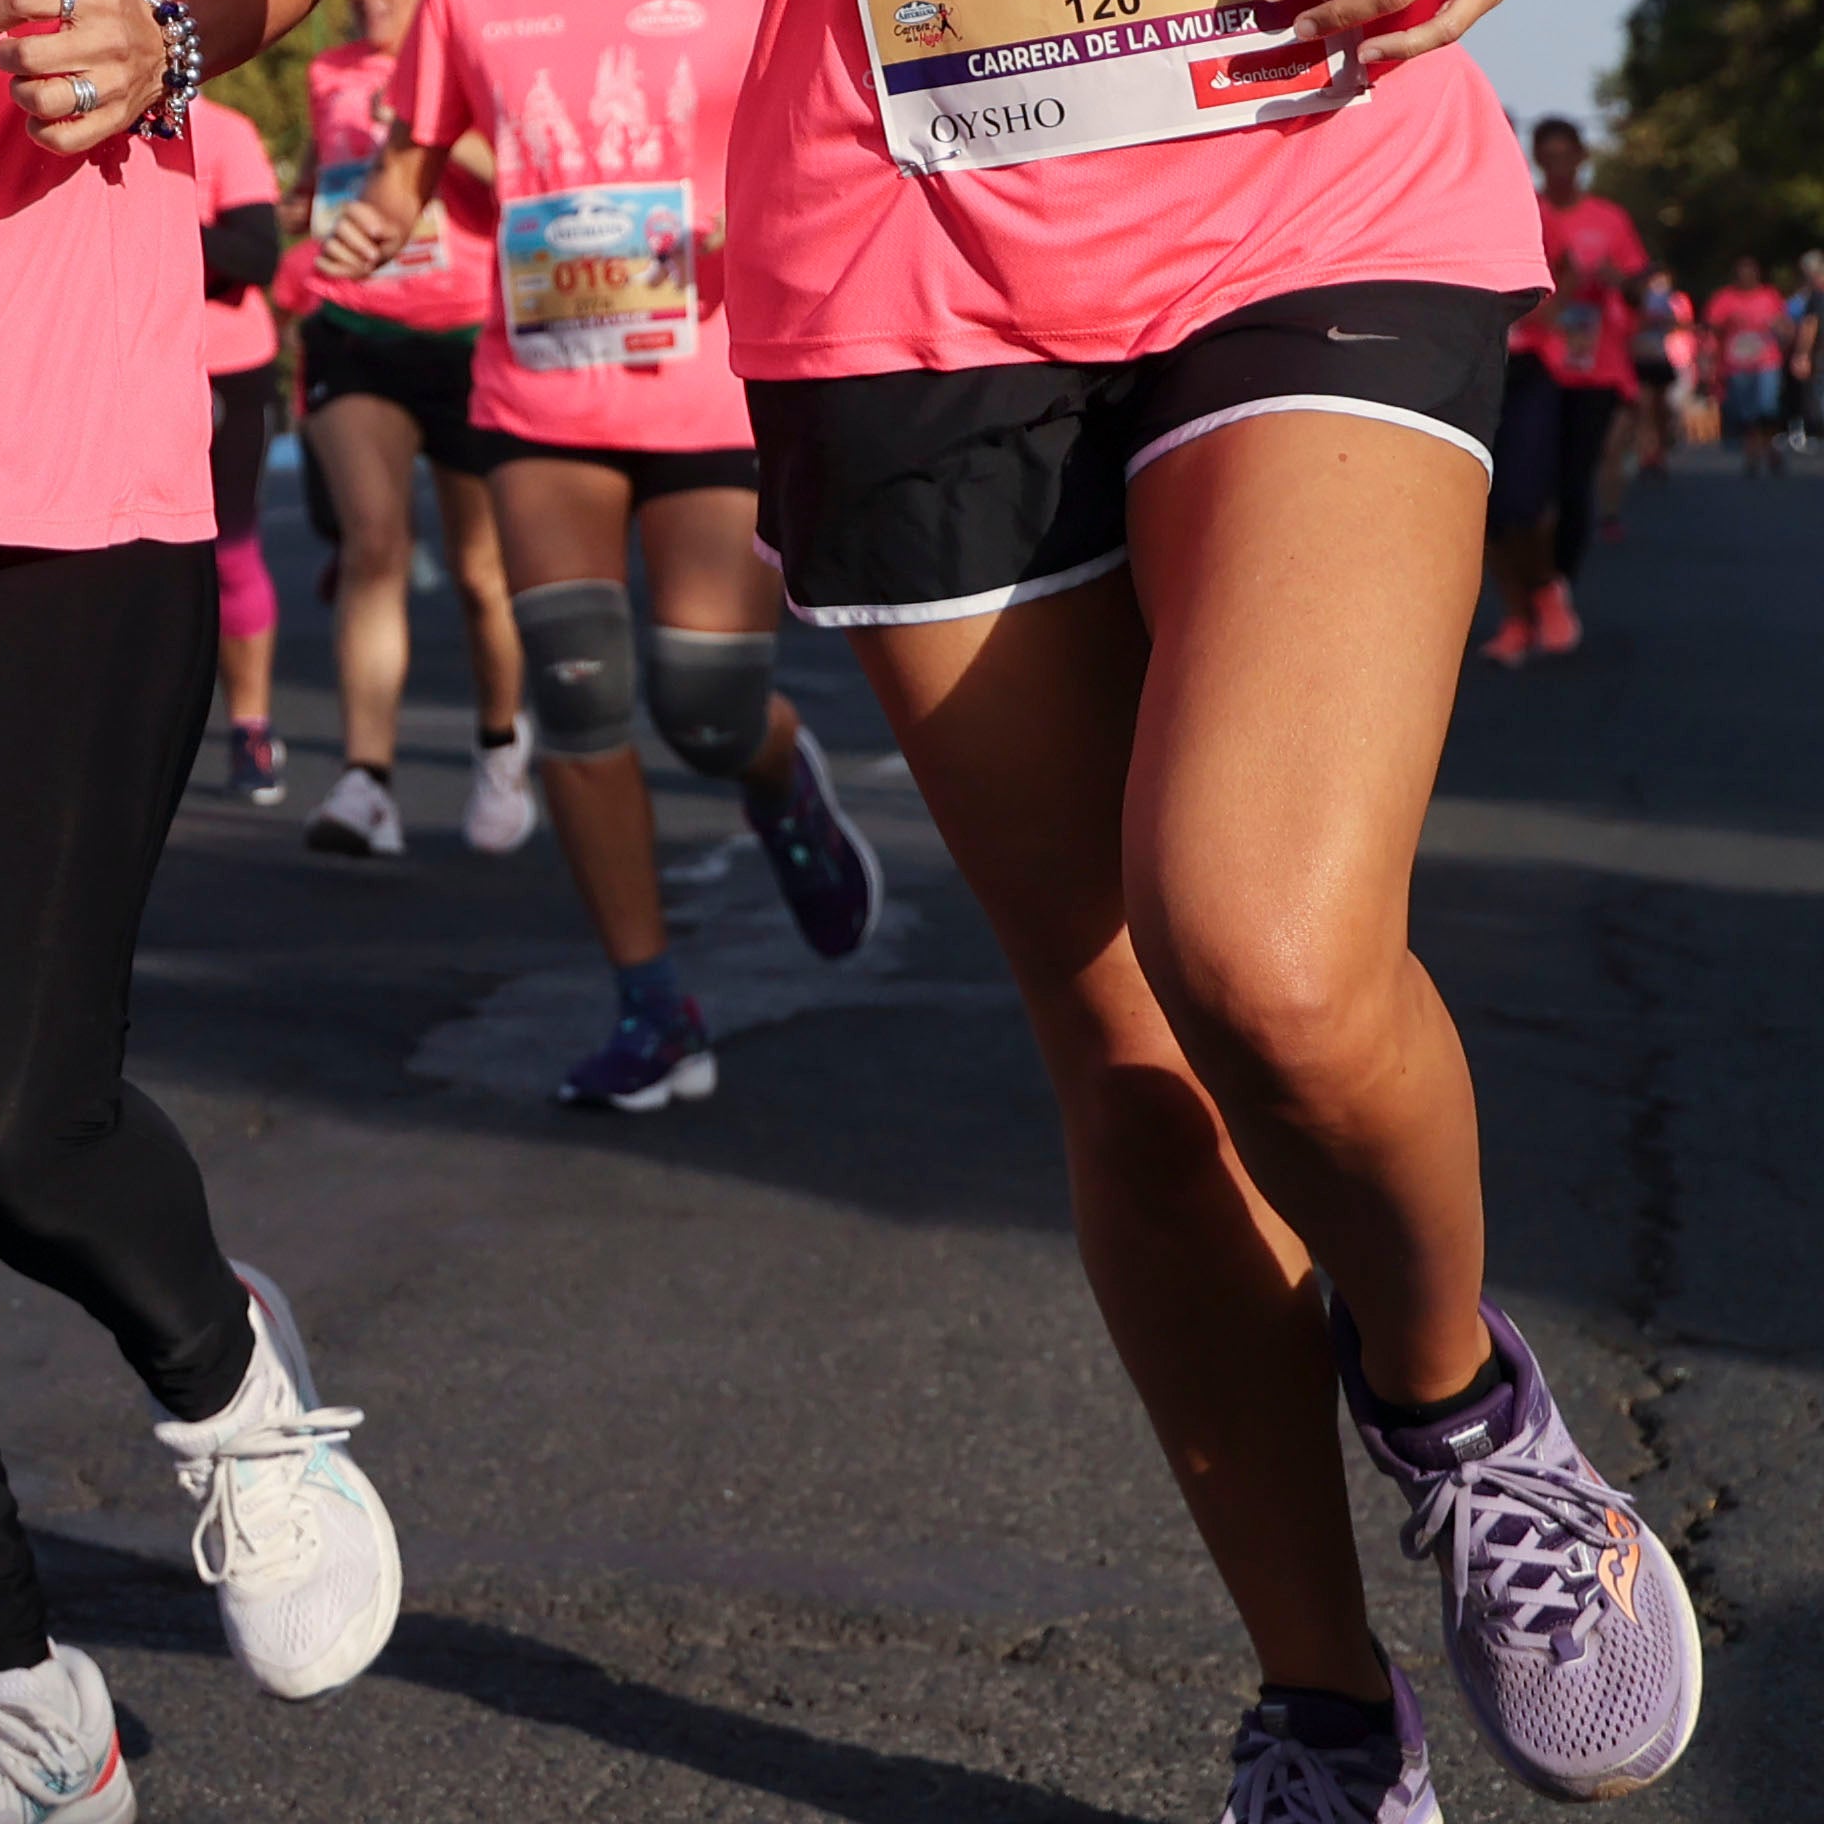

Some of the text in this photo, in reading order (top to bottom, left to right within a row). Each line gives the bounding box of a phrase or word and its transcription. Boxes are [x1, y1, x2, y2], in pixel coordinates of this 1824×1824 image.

[967, 7, 1258, 77] CARRERA DE LA MUJER
[931, 61, 1312, 143] OYSHO Santander
[555, 255, 628, 295] 016
